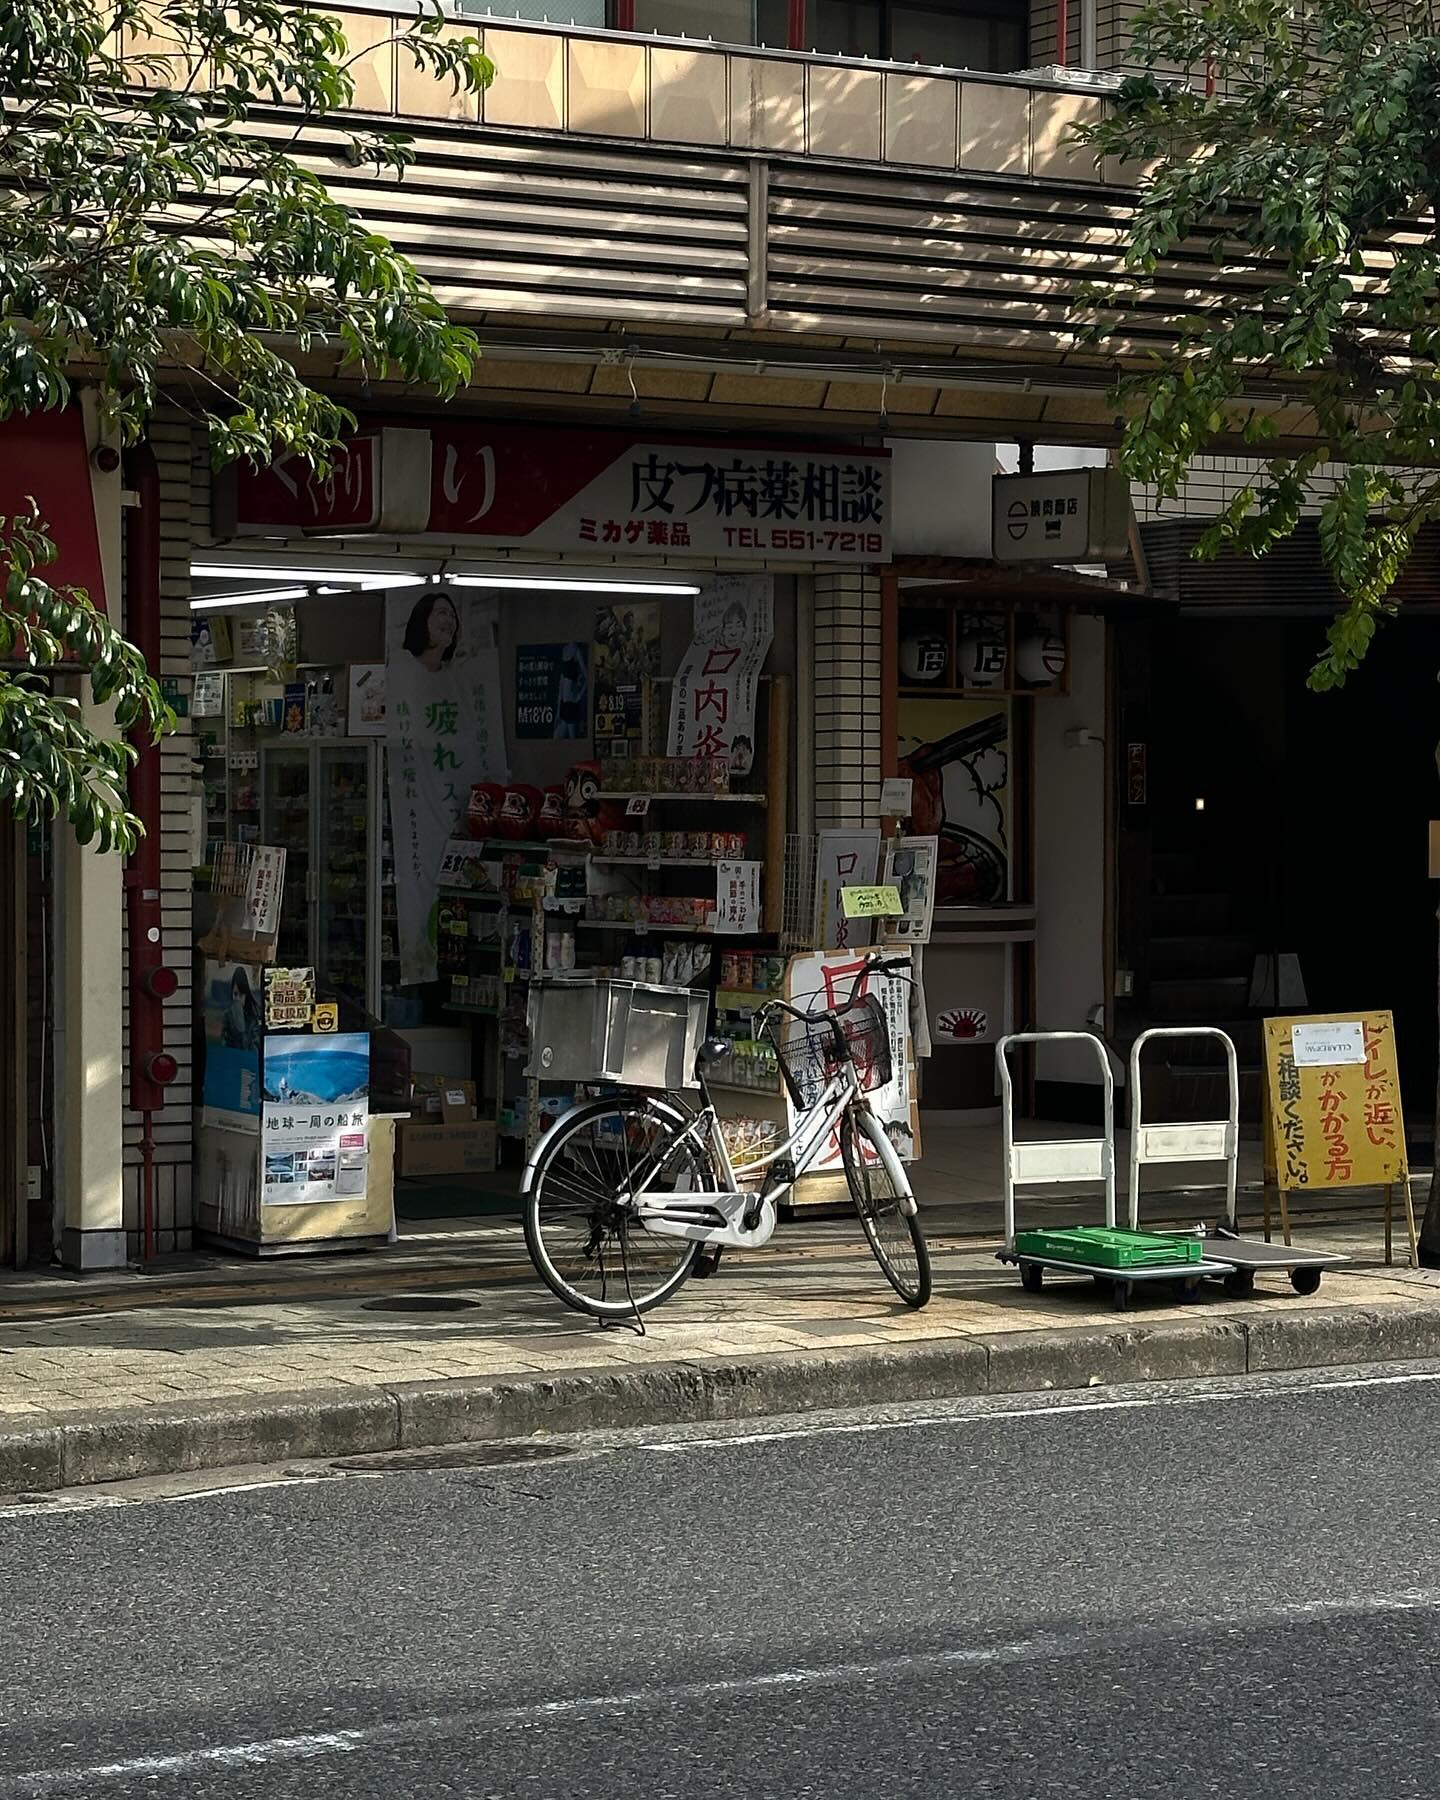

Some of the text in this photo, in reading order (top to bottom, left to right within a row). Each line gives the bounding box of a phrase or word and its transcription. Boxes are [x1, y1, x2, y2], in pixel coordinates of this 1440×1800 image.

[631, 454, 884, 523] 皮フ病薬相談
[579, 518, 691, 546] ミカゲ薬品
[723, 527, 883, 553] TEL 551-7219
[692, 648, 741, 758] 口内炎
[836, 853, 858, 949] 口炎
[266, 1111, 364, 1131] 地球一周の船旅
